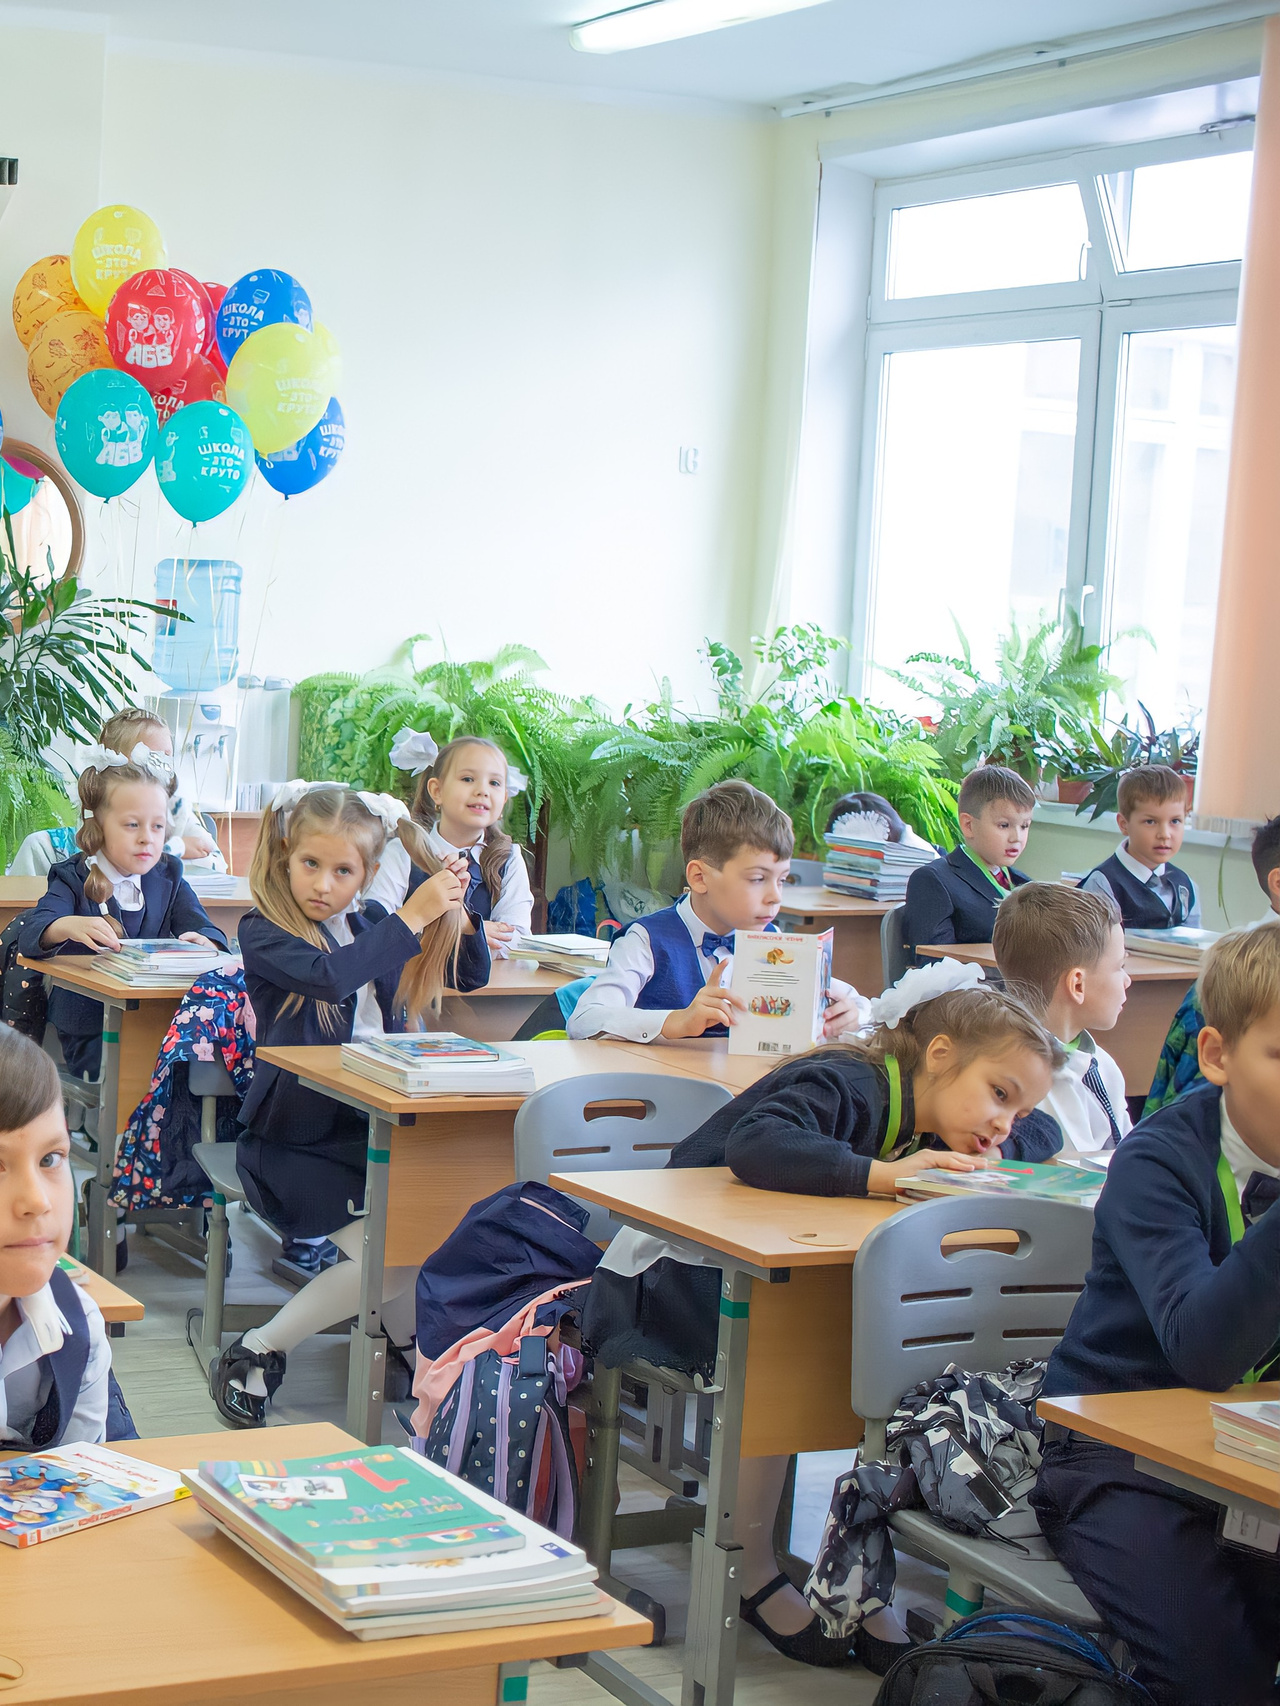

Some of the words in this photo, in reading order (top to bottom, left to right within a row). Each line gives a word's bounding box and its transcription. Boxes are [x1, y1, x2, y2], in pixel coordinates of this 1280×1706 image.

[92, 244, 141, 260] ШКОЛА
[222, 302, 264, 321] ШКОЛА
[222, 328, 250, 339] КРУТ
[198, 442, 245, 460] ШКОЛА
[201, 466, 240, 480] КРУТО
